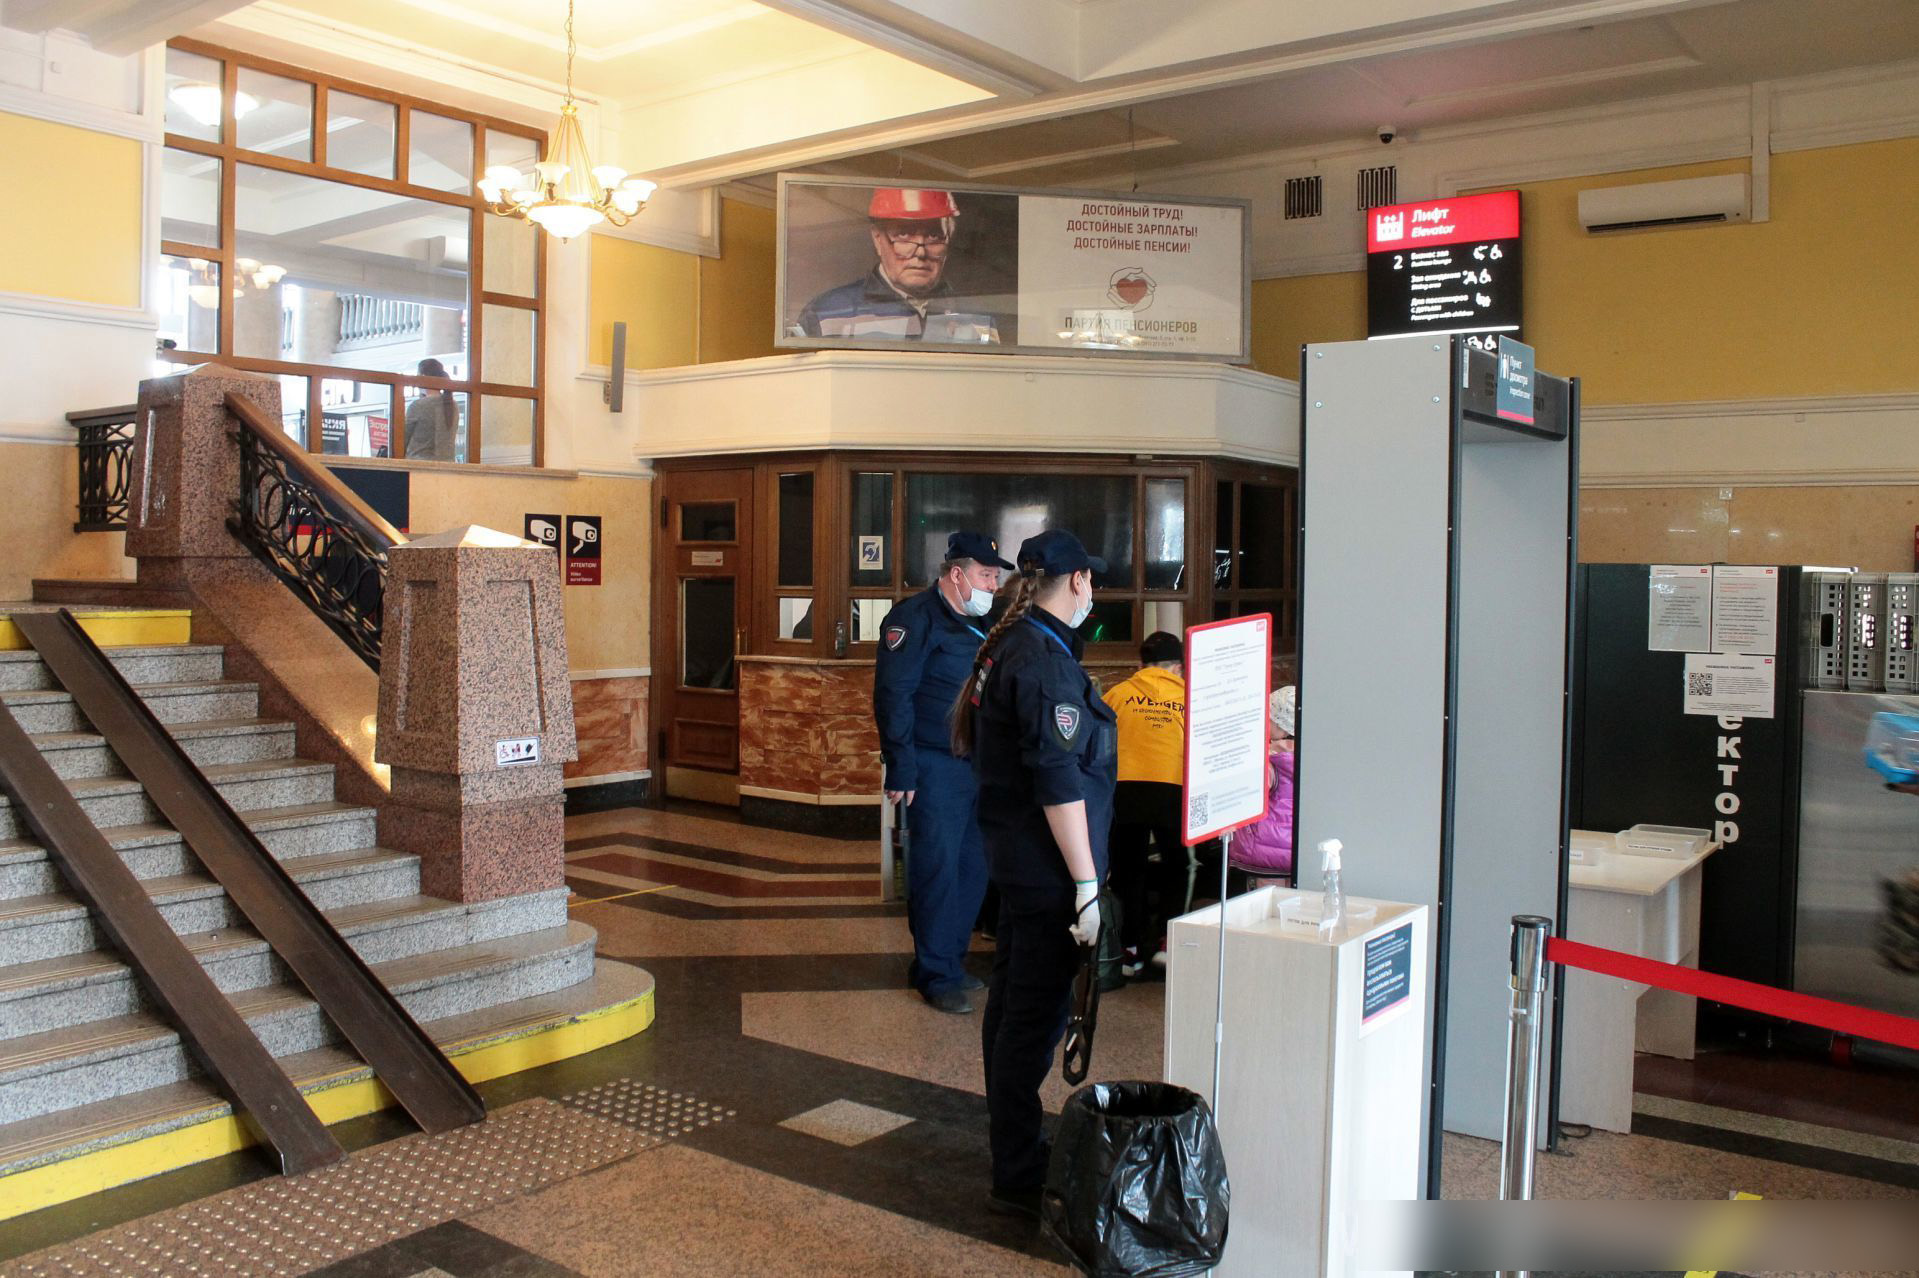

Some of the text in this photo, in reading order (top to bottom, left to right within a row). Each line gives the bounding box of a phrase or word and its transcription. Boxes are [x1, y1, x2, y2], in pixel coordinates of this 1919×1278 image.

[1082, 203, 1184, 220] ДОСТОЙНЫЙ ТРУД!
[1411, 207, 1450, 223] Лифт
[1067, 219, 1198, 237] ДОСТОЙНЫЕ ЗАРПЛАТЫ!
[1411, 224, 1455, 238] Elevator
[1074, 236, 1191, 253] ДОСТОЙНЫЕ ПЕНСИИ!
[1393, 255, 1403, 270] 2
[1115, 318, 1197, 333] ПЕНСИОНЕРОВ
